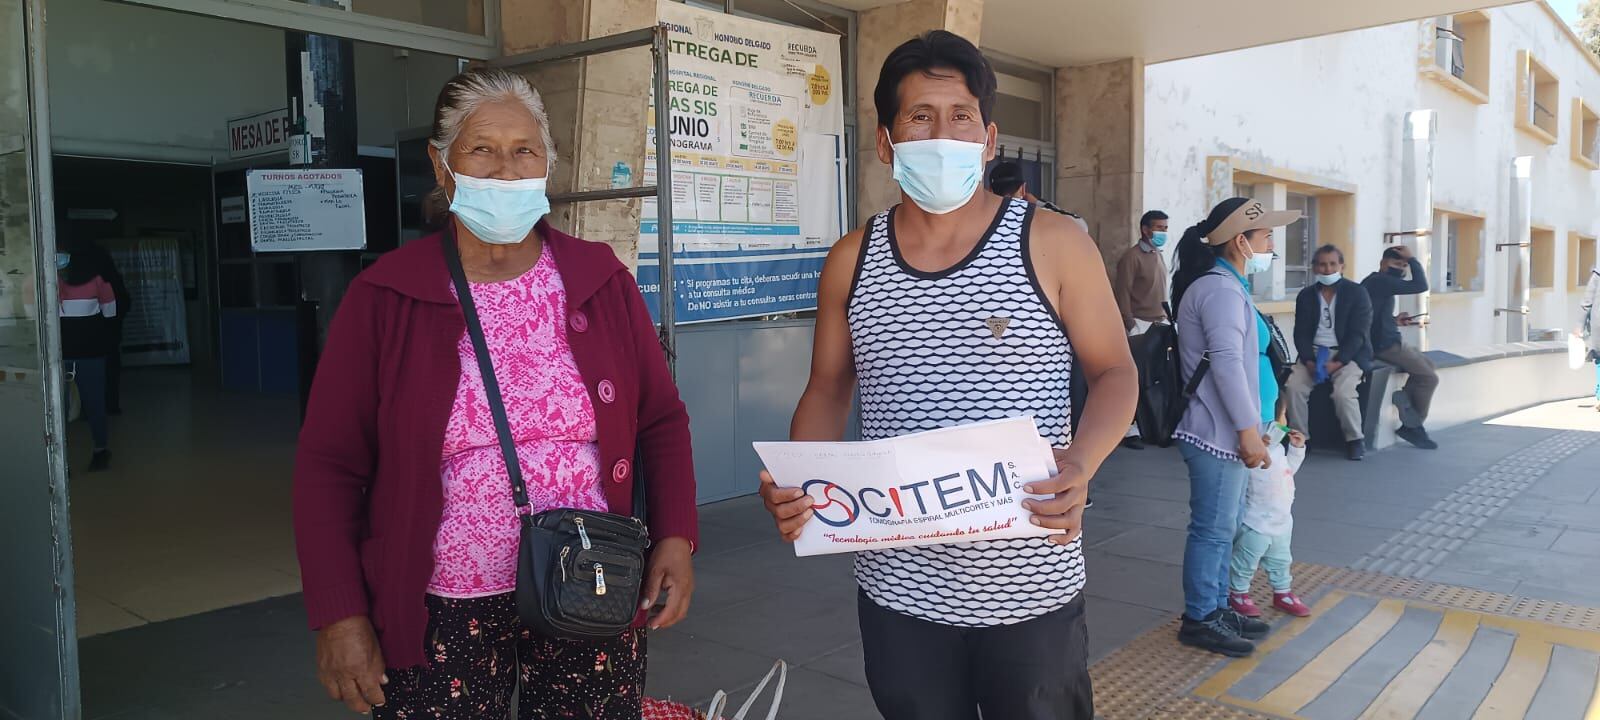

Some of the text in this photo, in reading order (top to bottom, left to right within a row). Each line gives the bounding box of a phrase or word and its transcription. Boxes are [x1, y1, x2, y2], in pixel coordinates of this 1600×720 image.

[667, 40, 759, 68] NTREGA DE
[702, 85, 718, 97] DE
[748, 91, 782, 103] RECUERDA
[694, 100, 718, 117] SIS
[232, 121, 265, 151] MESA
[265, 118, 280, 142] DE
[1245, 202, 1264, 220] SP
[687, 279, 694, 288] Si
[695, 279, 731, 289] programas
[732, 277, 739, 285] tu
[801, 272, 813, 280] una
[693, 290, 701, 298] tu
[703, 287, 731, 298] consulta
[699, 300, 711, 310] NO
[747, 295, 776, 306] consulta
[858, 461, 1012, 518] CITEM
[913, 513, 944, 524] ESPIRAL
[944, 503, 990, 518] MULTICORTE
[918, 528, 965, 539] cuidando
[968, 525, 979, 535] tu
